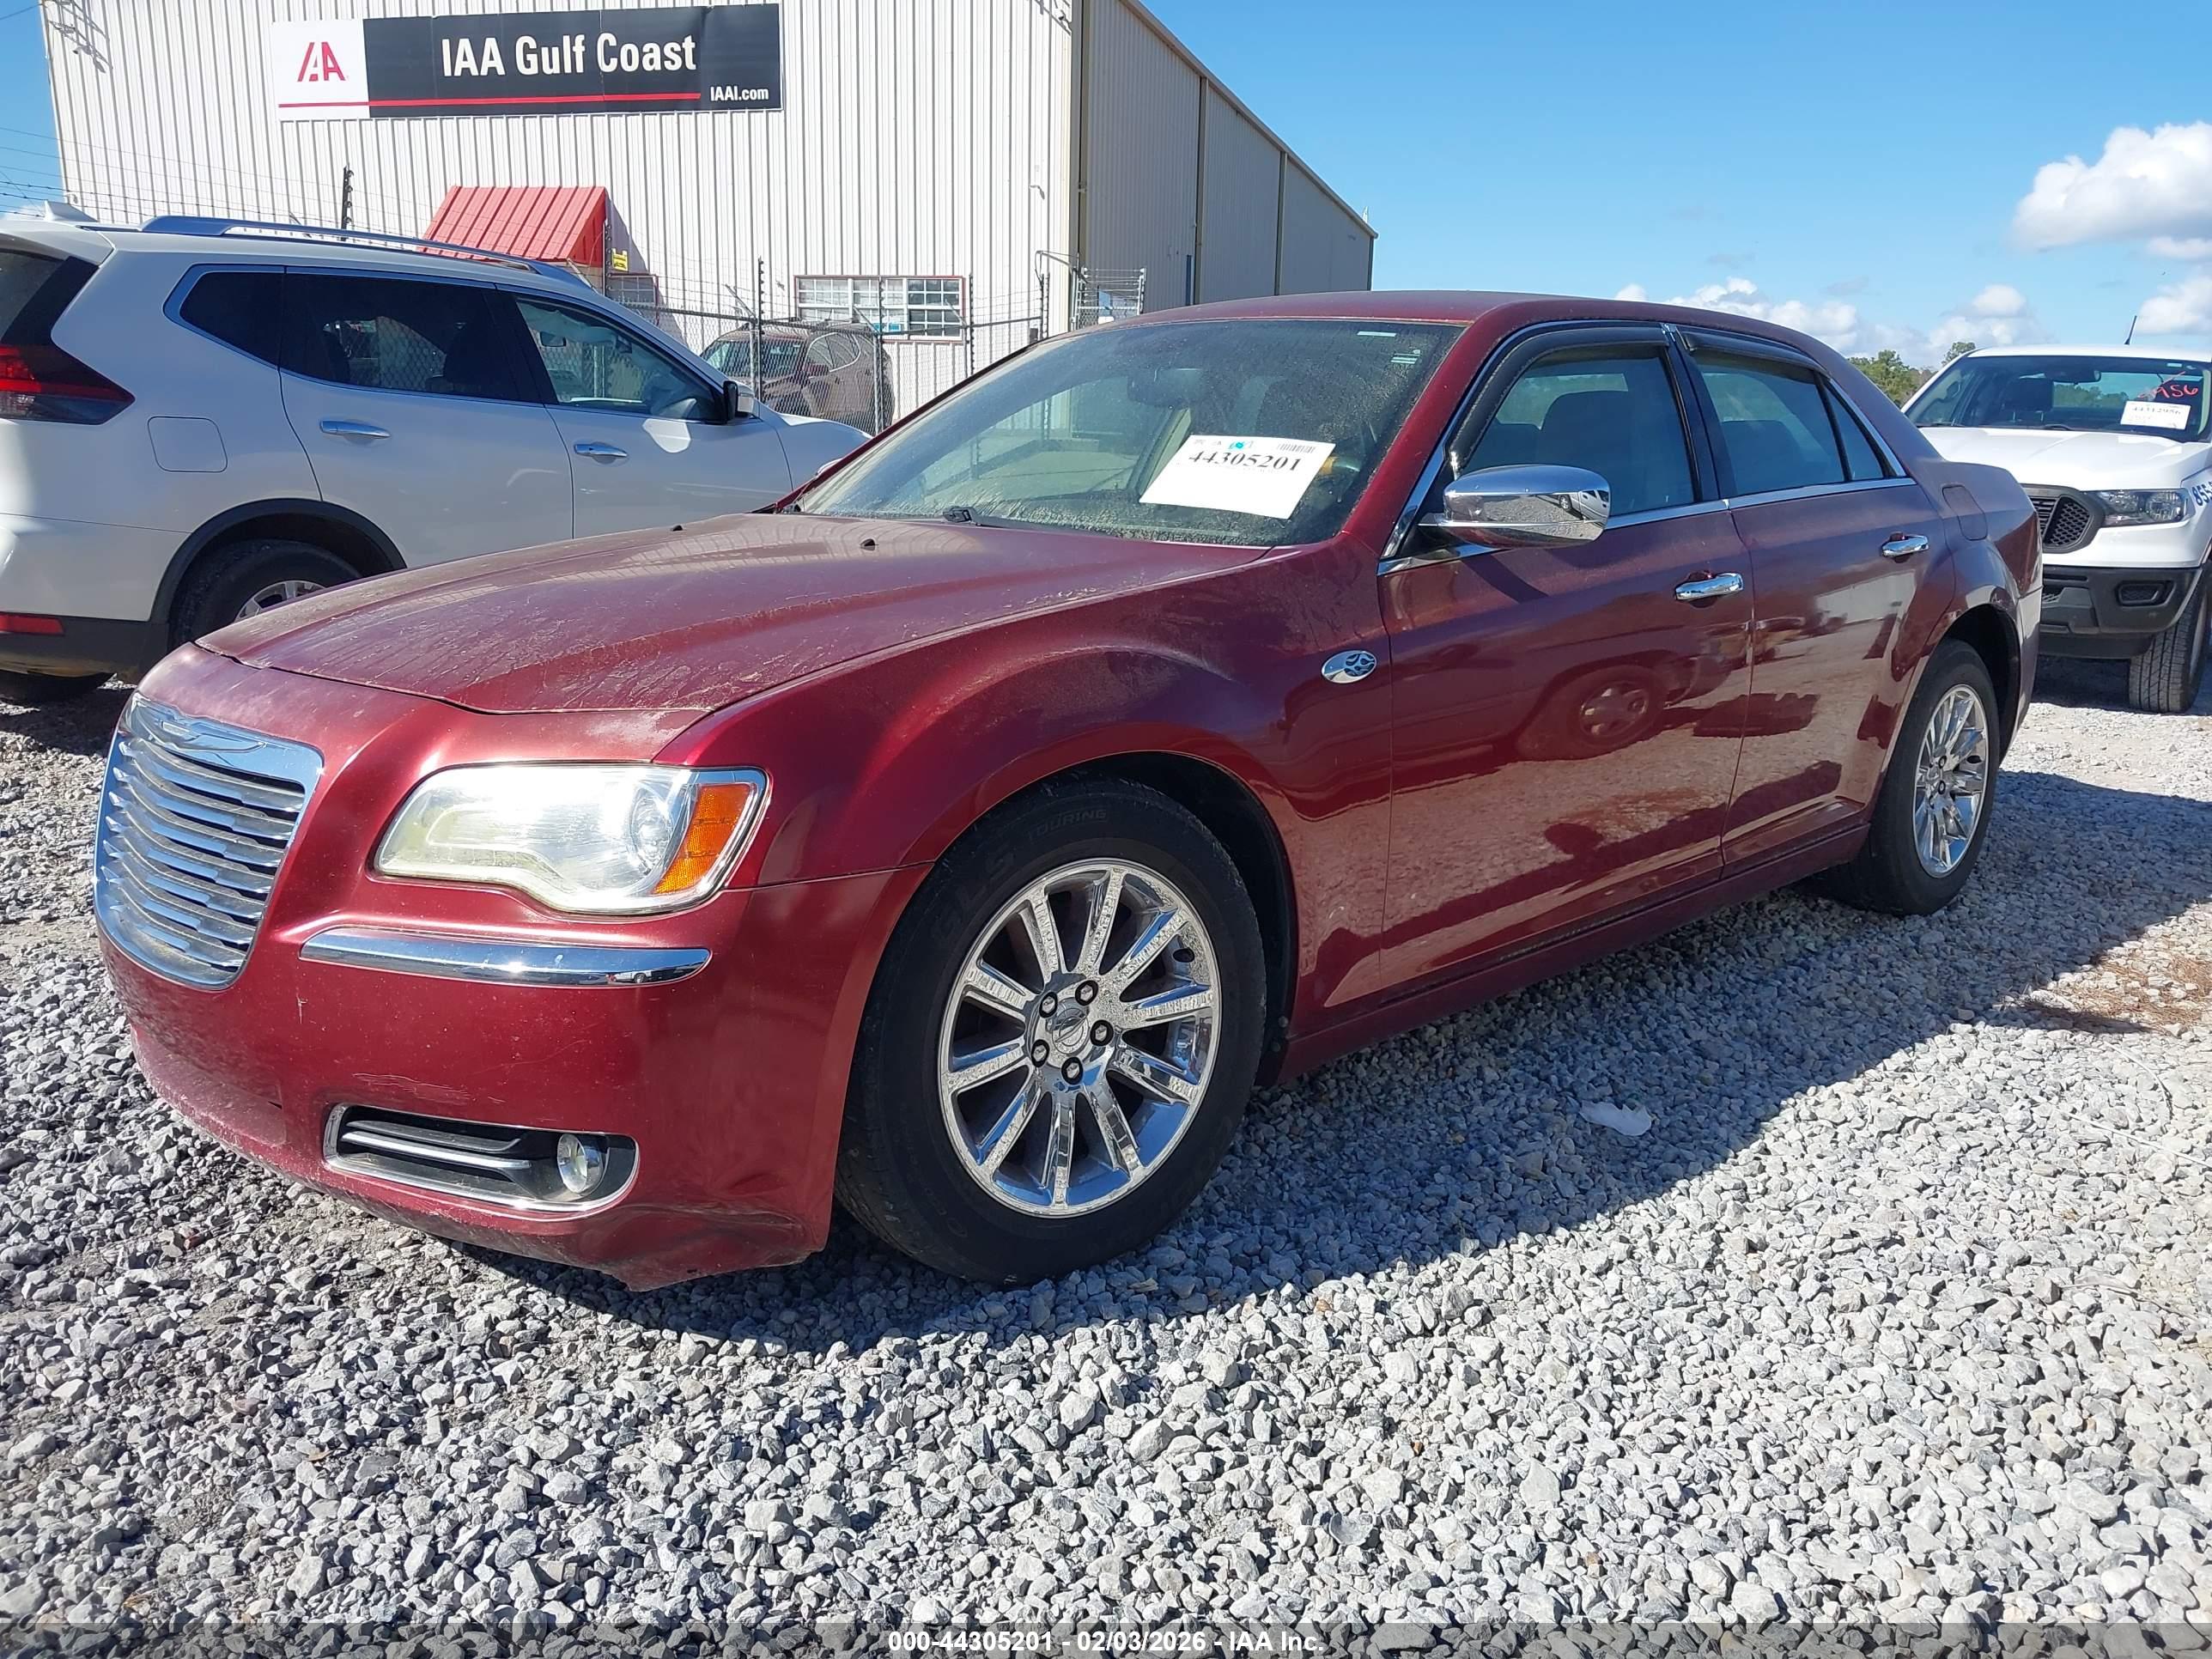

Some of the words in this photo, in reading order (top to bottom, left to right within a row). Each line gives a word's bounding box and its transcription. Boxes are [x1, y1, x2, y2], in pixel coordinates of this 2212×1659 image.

[441, 37, 506, 76] IAA
[515, 34, 586, 76] Gulf
[597, 32, 697, 73] Coast
[710, 86, 769, 101] IAAI.com
[1188, 450, 1302, 471] 44305201
